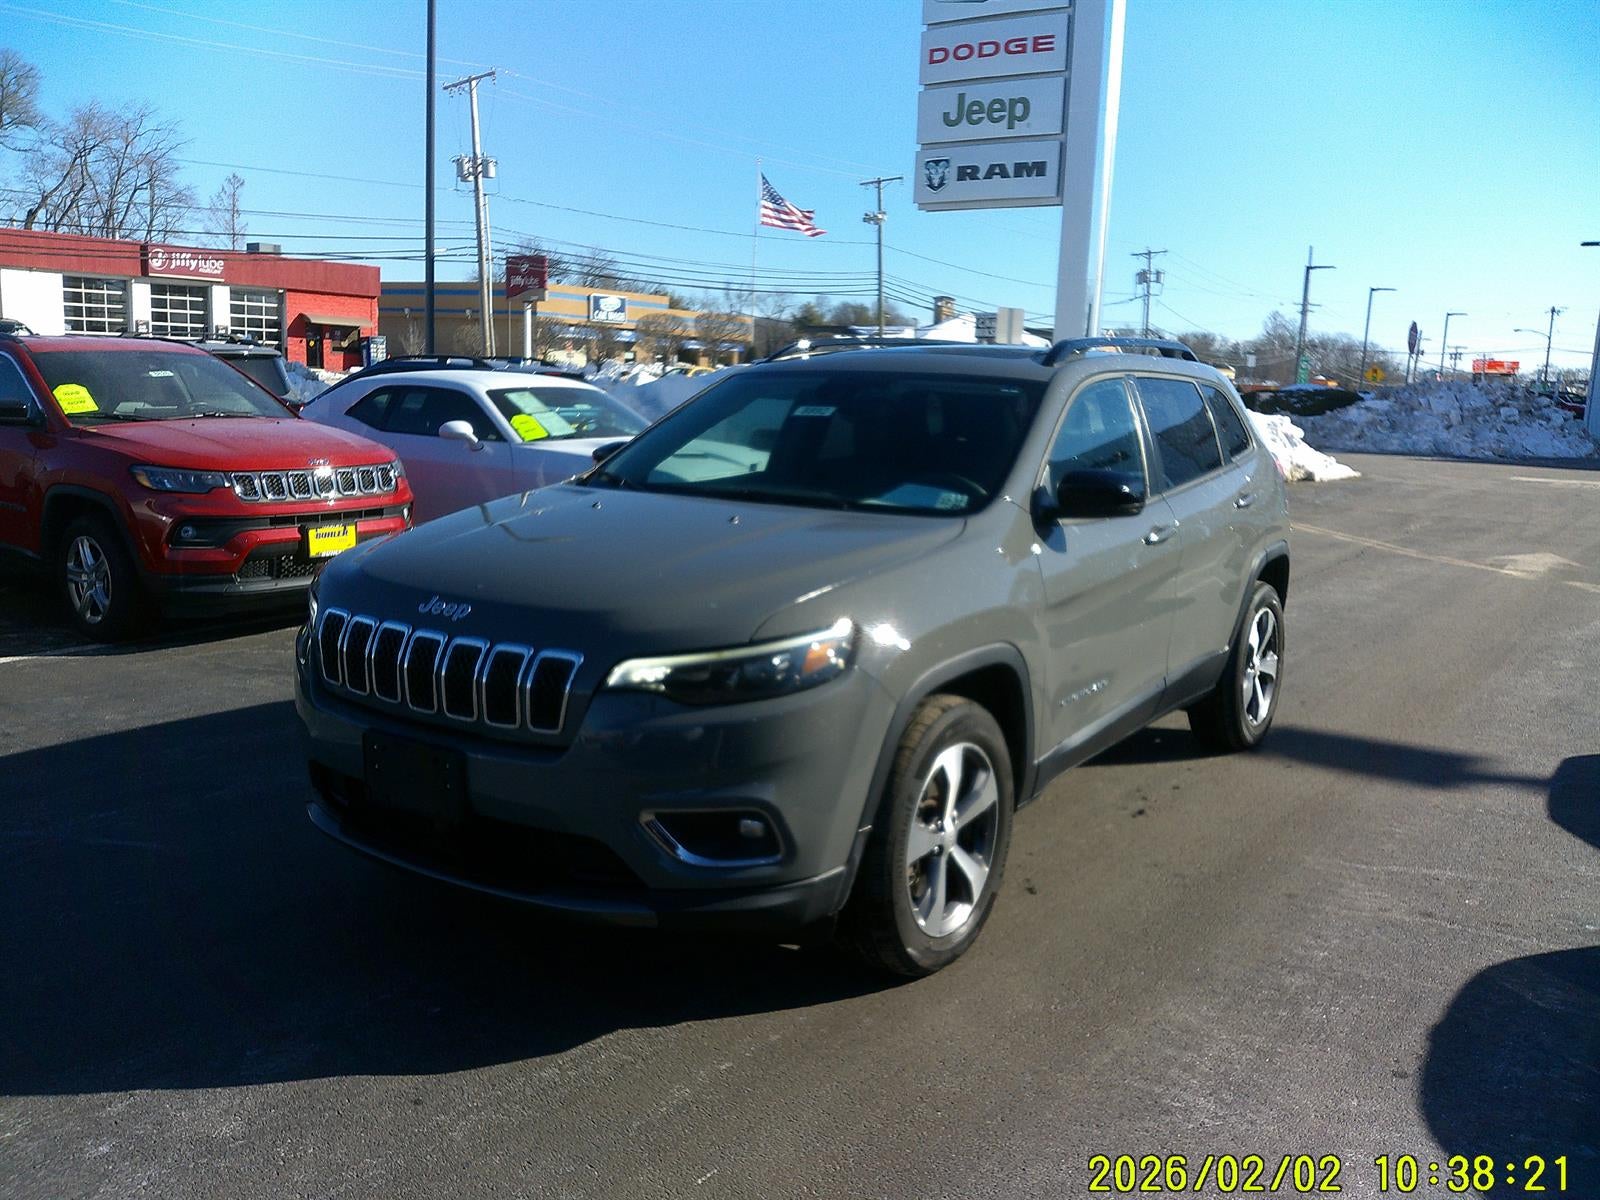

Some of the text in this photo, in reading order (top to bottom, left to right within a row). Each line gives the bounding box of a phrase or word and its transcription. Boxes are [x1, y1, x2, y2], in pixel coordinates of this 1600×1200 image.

[928, 34, 1056, 65] DODGE
[942, 92, 1031, 130] Jeep
[956, 160, 1047, 182] RAM
[170, 252, 225, 271] jiffy lube
[418, 594, 472, 621] Jeep
